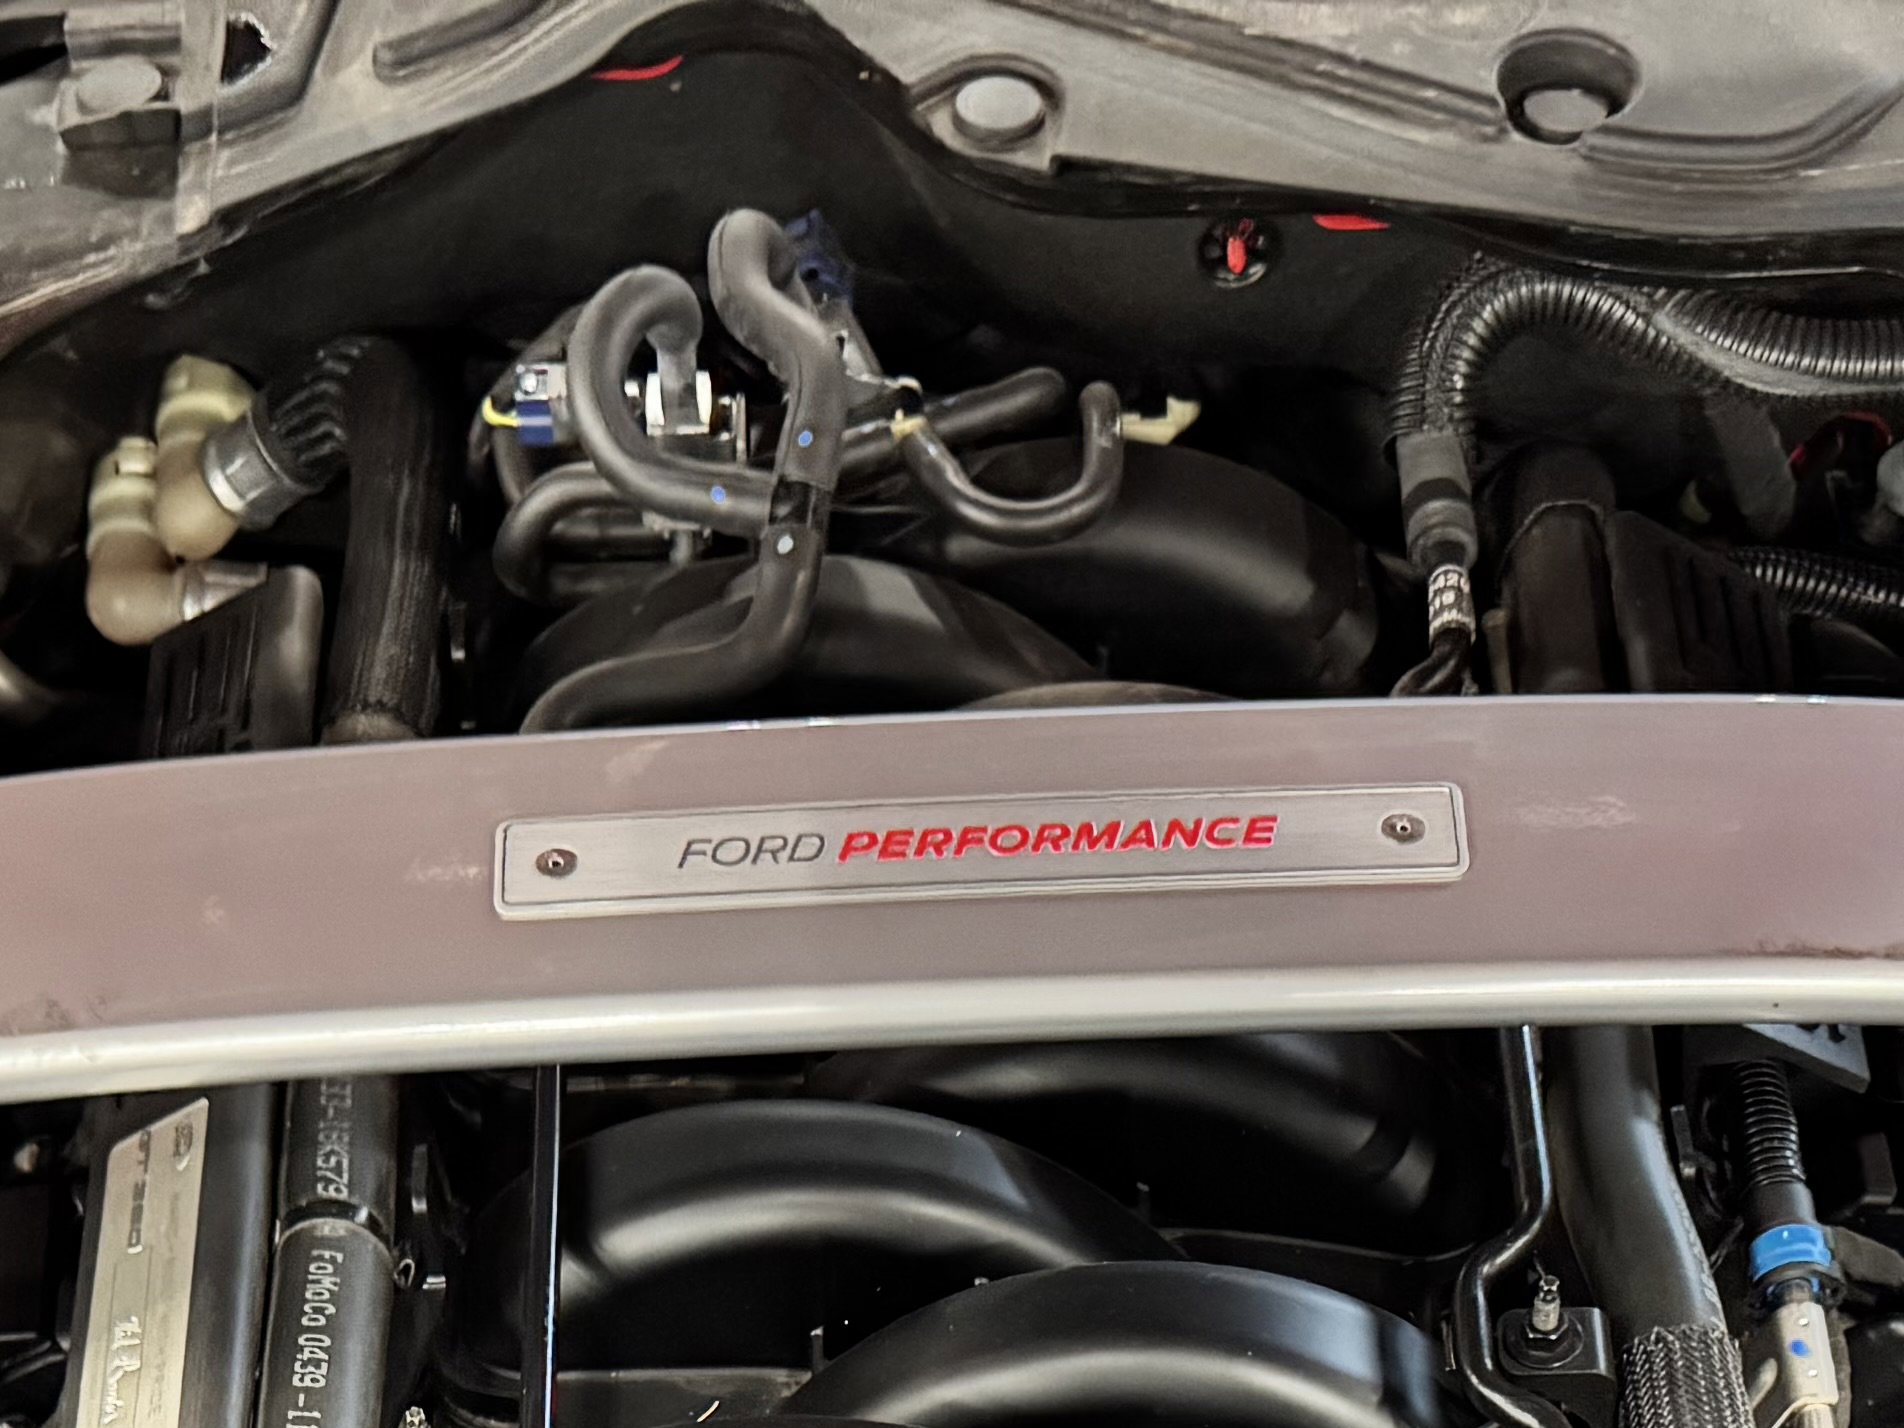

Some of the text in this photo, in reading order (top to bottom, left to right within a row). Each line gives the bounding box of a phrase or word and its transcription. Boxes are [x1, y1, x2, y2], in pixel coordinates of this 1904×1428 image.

[676, 813, 1284, 871] FORD PERFORMANCE
[300, 1249, 345, 1328] FoMoCo
